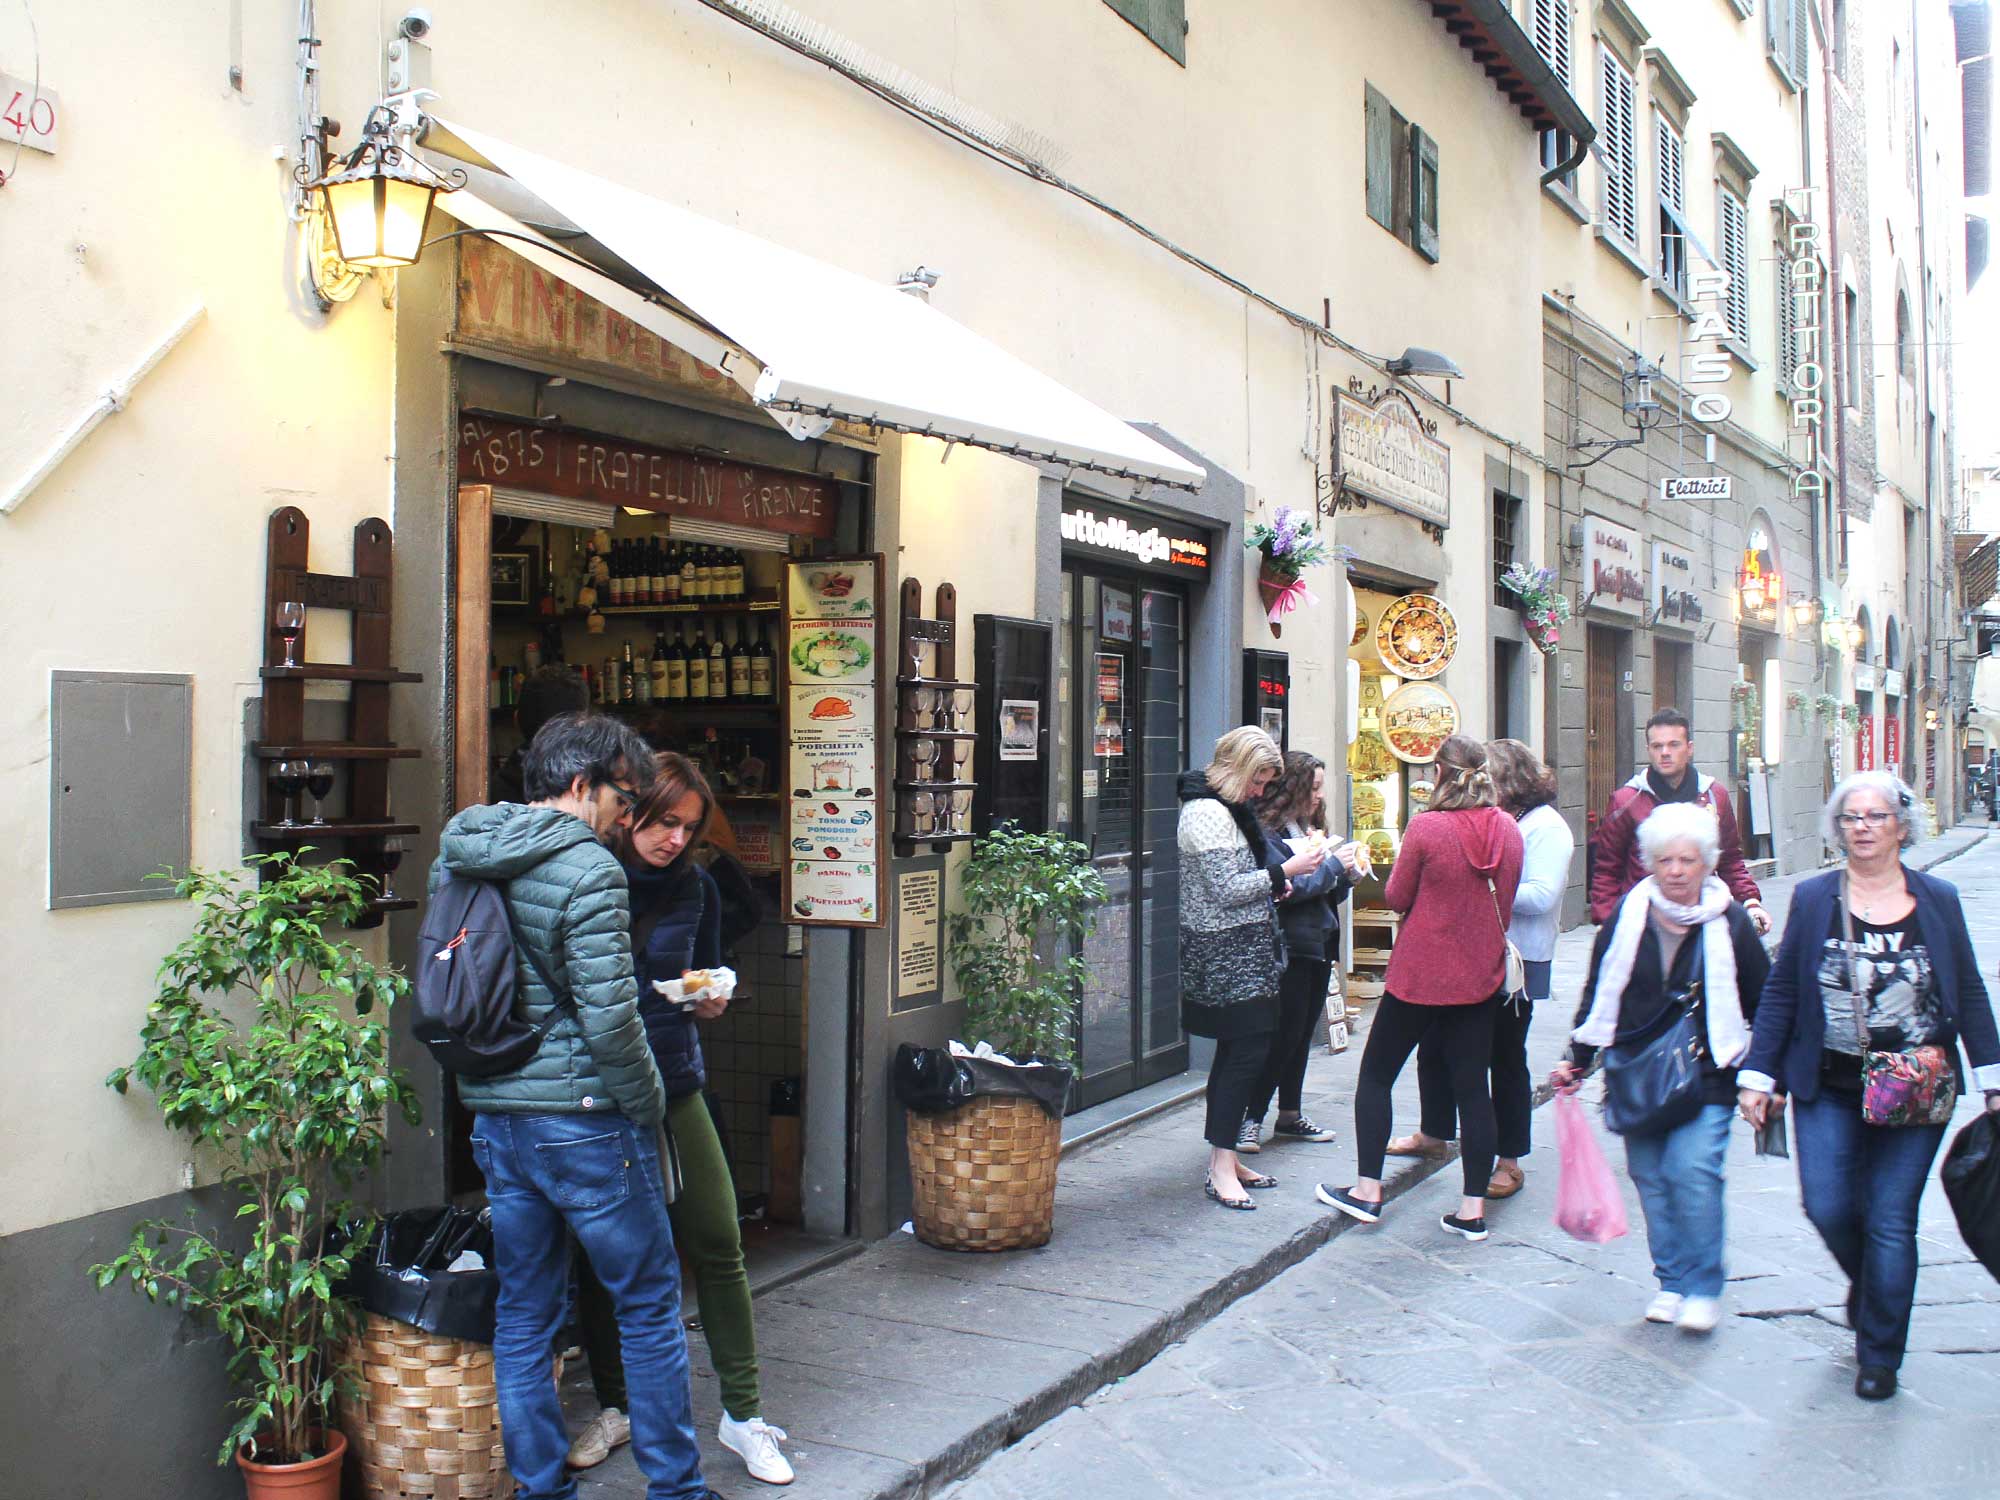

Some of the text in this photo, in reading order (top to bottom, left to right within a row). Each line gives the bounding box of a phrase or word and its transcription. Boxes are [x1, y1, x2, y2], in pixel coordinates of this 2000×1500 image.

[2, 92, 54, 135] 40
[469, 253, 582, 345] VINI
[1789, 186, 1823, 497] TRATTORIA
[1687, 271, 1732, 463] RASOI
[472, 429, 544, 478] 1875
[1665, 477, 1727, 498] Elettrici
[807, 826, 858, 834] POMODORO
[818, 817, 846, 825] TONNO
[1864, 932, 1904, 953] NY
